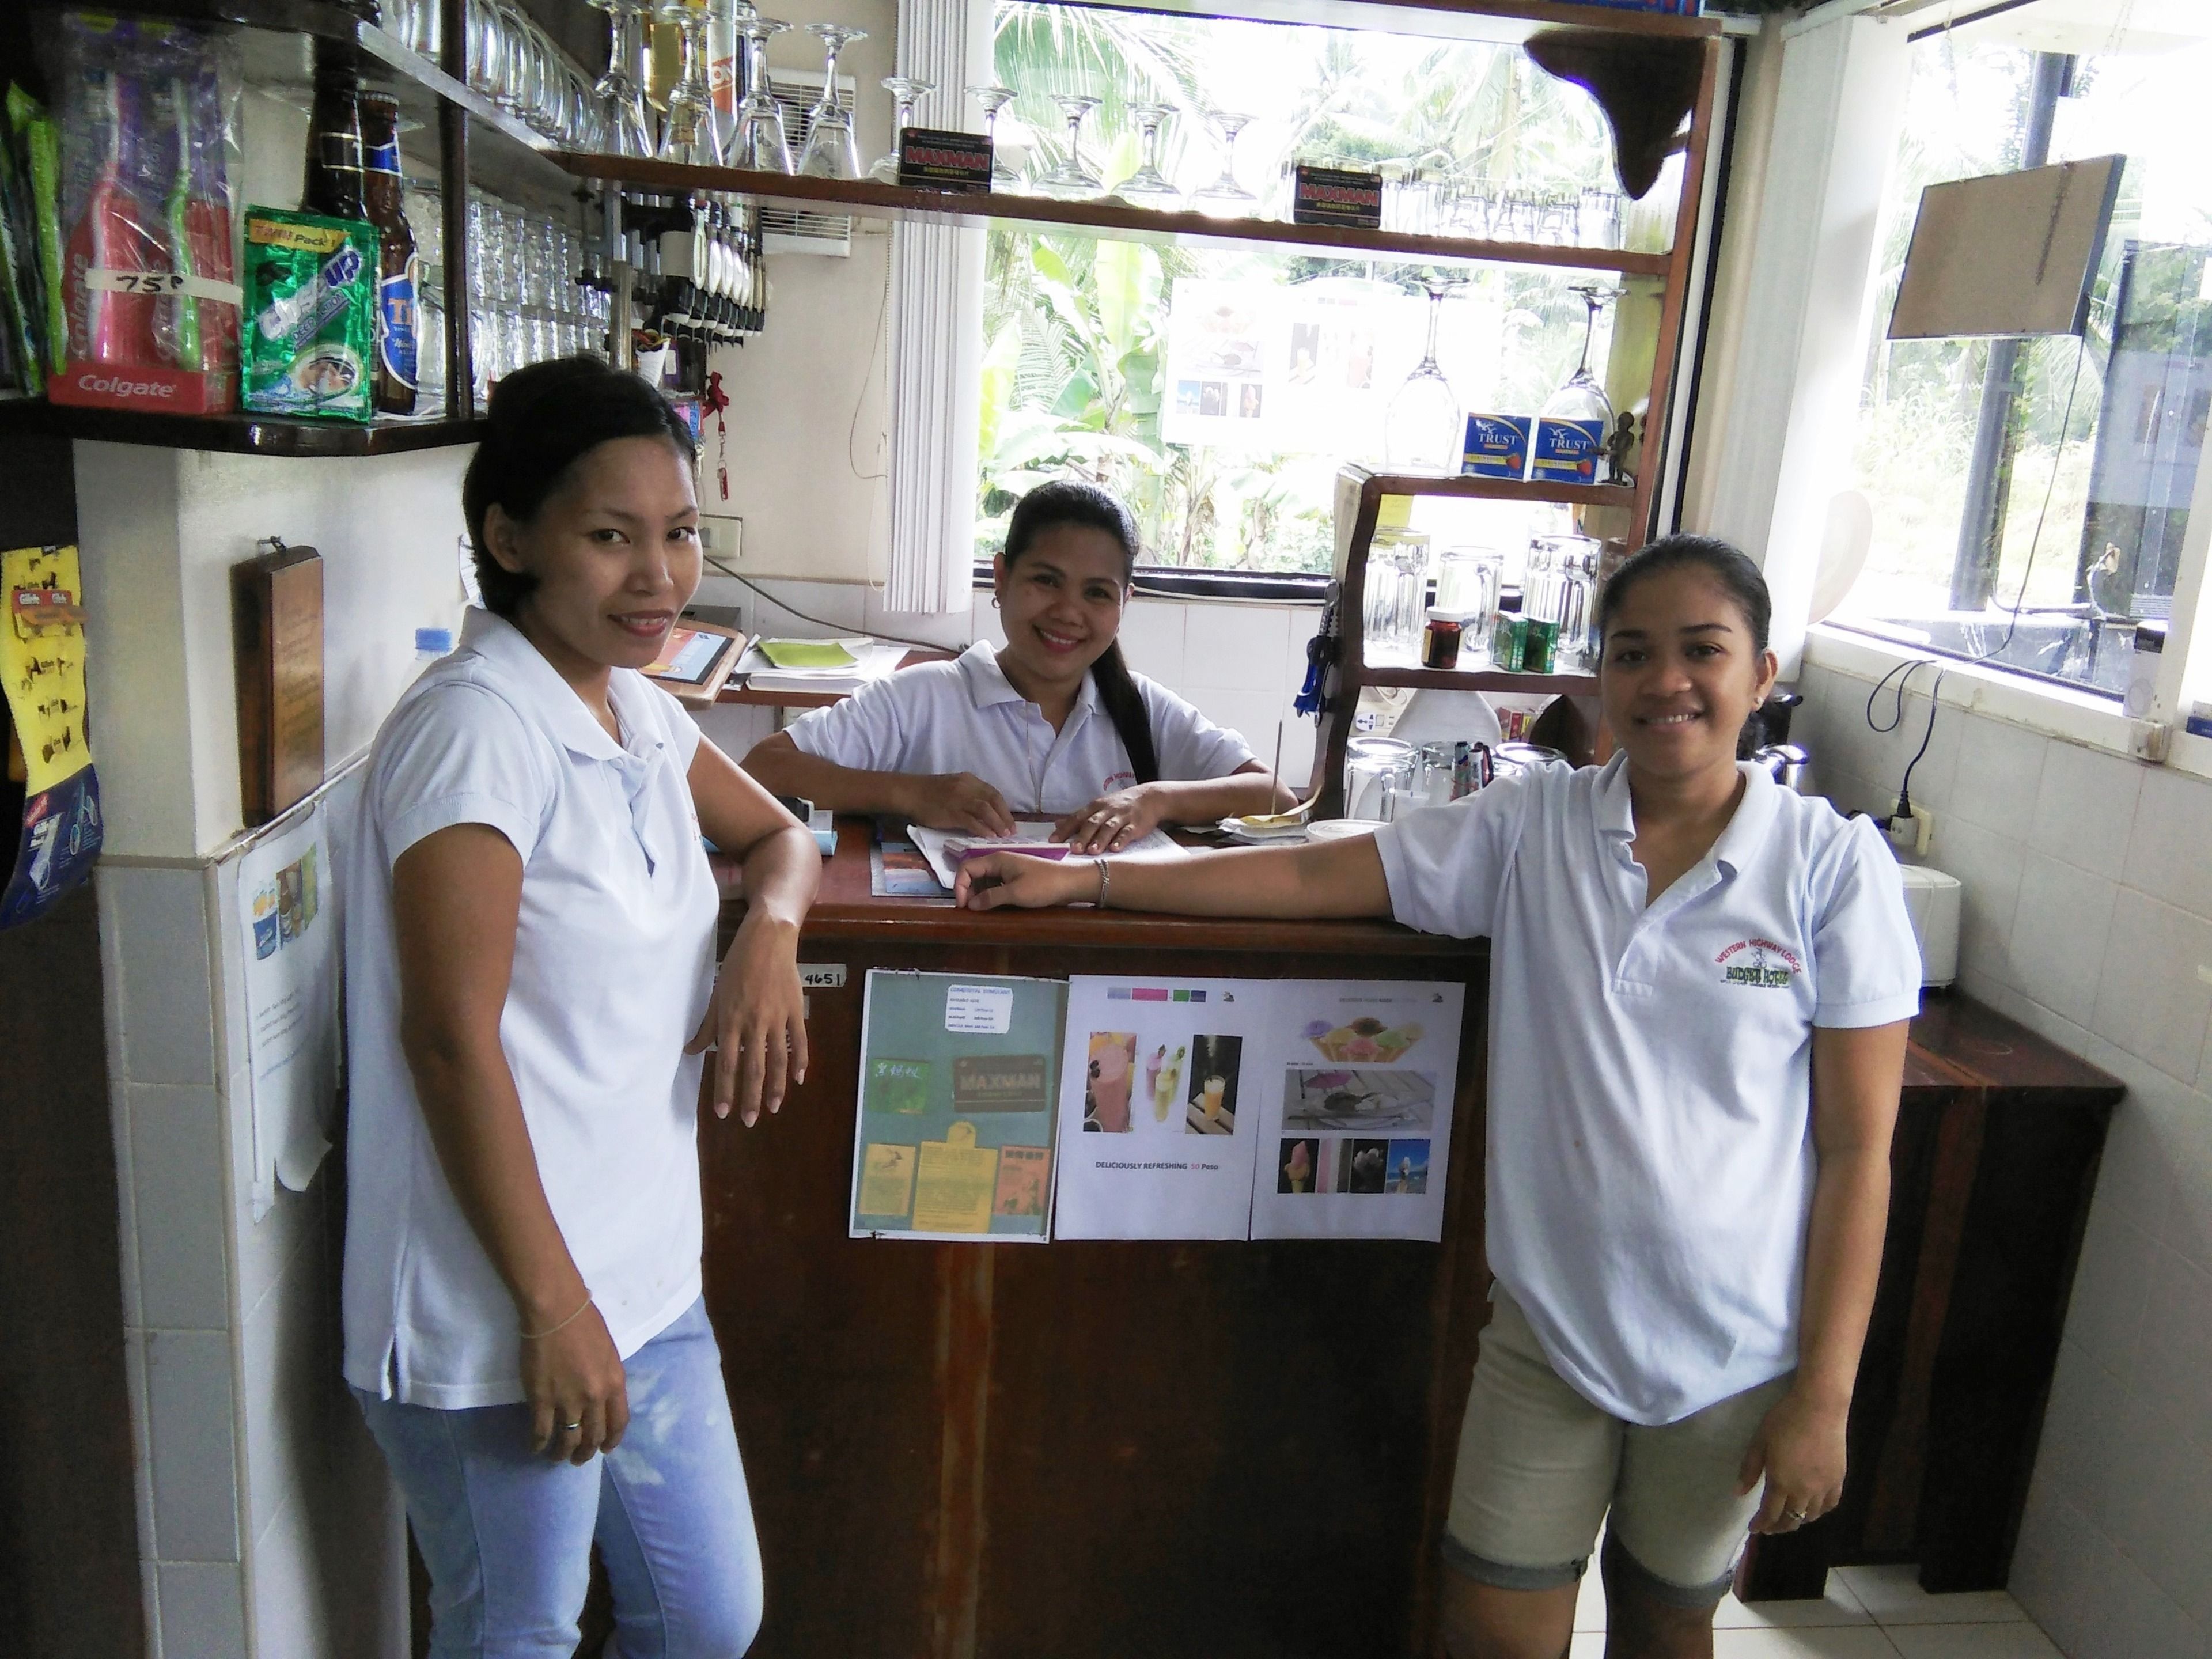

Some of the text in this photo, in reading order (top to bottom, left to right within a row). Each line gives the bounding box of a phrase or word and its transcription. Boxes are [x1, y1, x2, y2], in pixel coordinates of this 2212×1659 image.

[906, 145, 991, 171] MAXMAN
[1300, 183, 1380, 207] MAXMAN
[79, 374, 175, 397] Colgate
[1479, 433, 1517, 445] TRUST
[1550, 438, 1589, 450] TRUST
[1714, 938, 1802, 974] WESTERN HIGHWAY LODGE
[805, 973, 840, 986] 4651
[1726, 966, 1762, 983] BUDGET
[960, 1072, 1041, 1090] MAXMAN
[1095, 1161, 1142, 1169] DELICIOUSLY
[1143, 1162, 1187, 1170] REFRESHING
